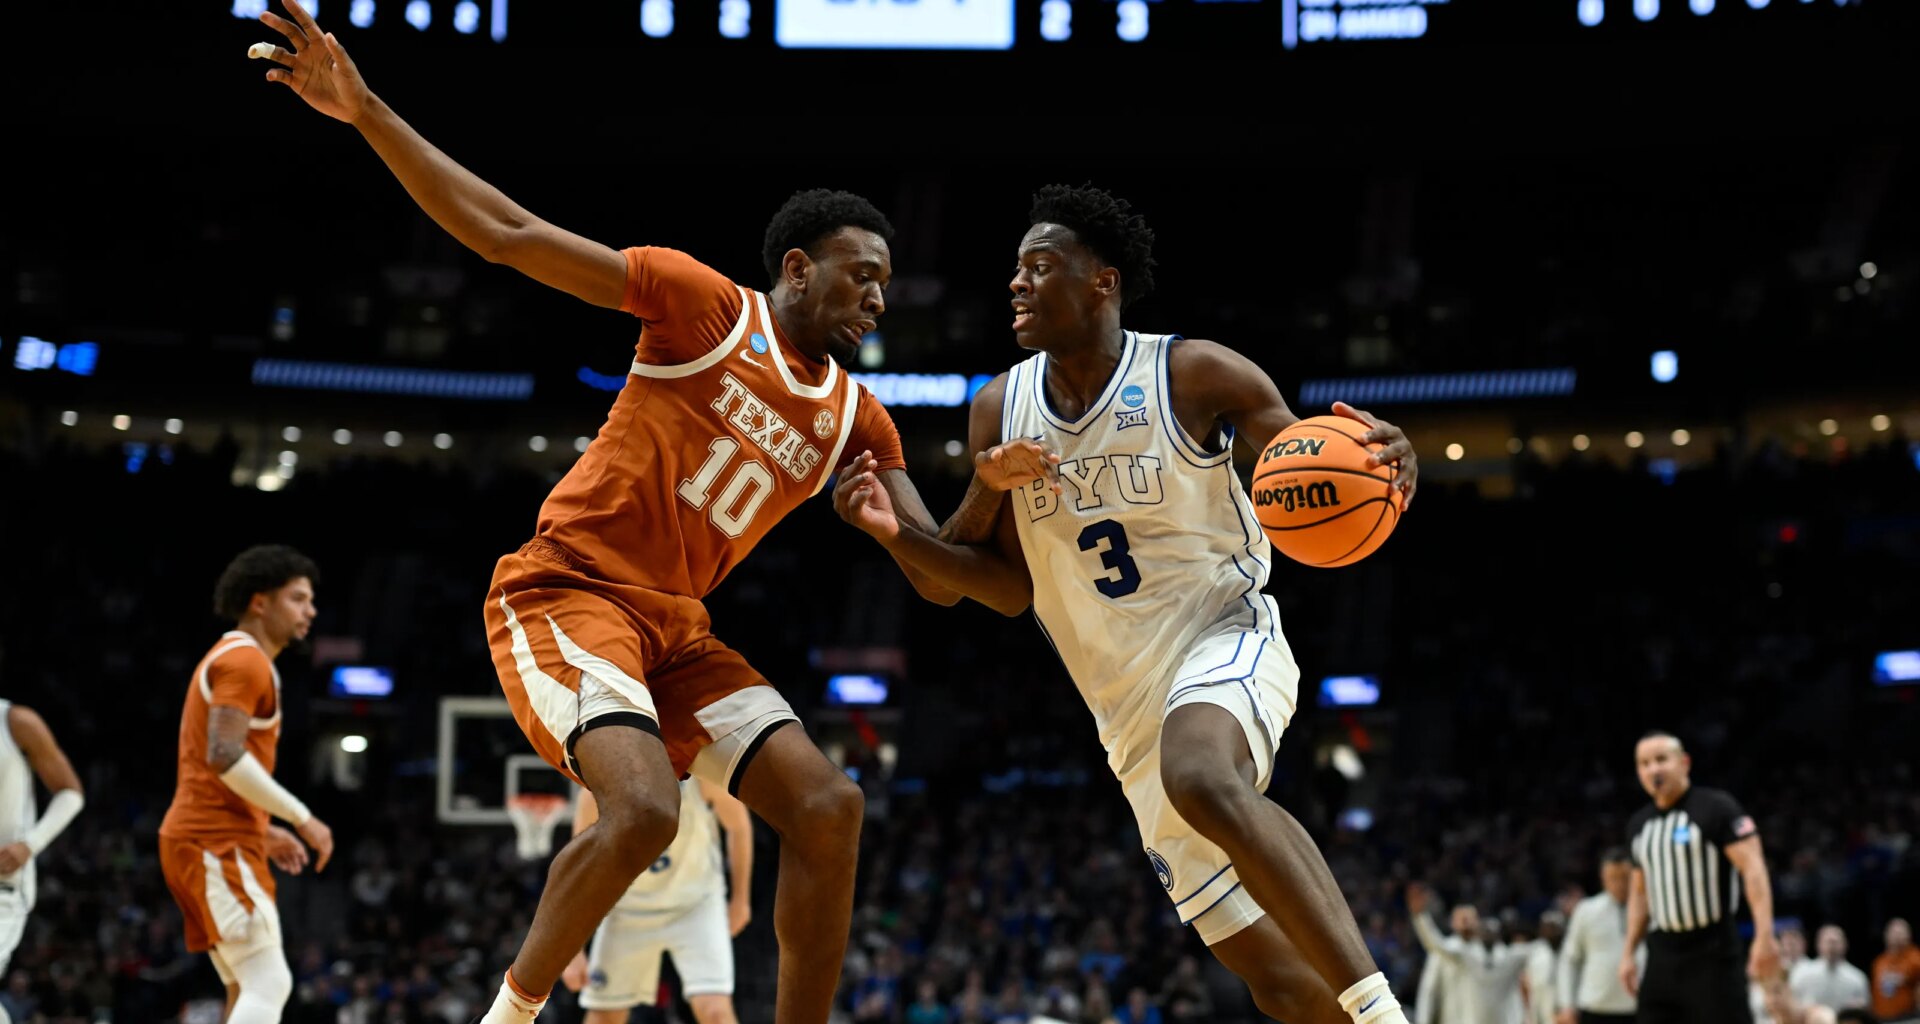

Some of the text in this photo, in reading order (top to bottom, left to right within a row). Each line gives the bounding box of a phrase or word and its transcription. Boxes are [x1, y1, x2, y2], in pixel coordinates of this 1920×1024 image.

[710, 371, 823, 482] TEXAS
[1262, 438, 1326, 464] NCAA
[675, 436, 775, 539] 10
[1018, 454, 1164, 523] BYU
[1254, 480, 1341, 513] Wilson
[1077, 518, 1142, 599] 3
